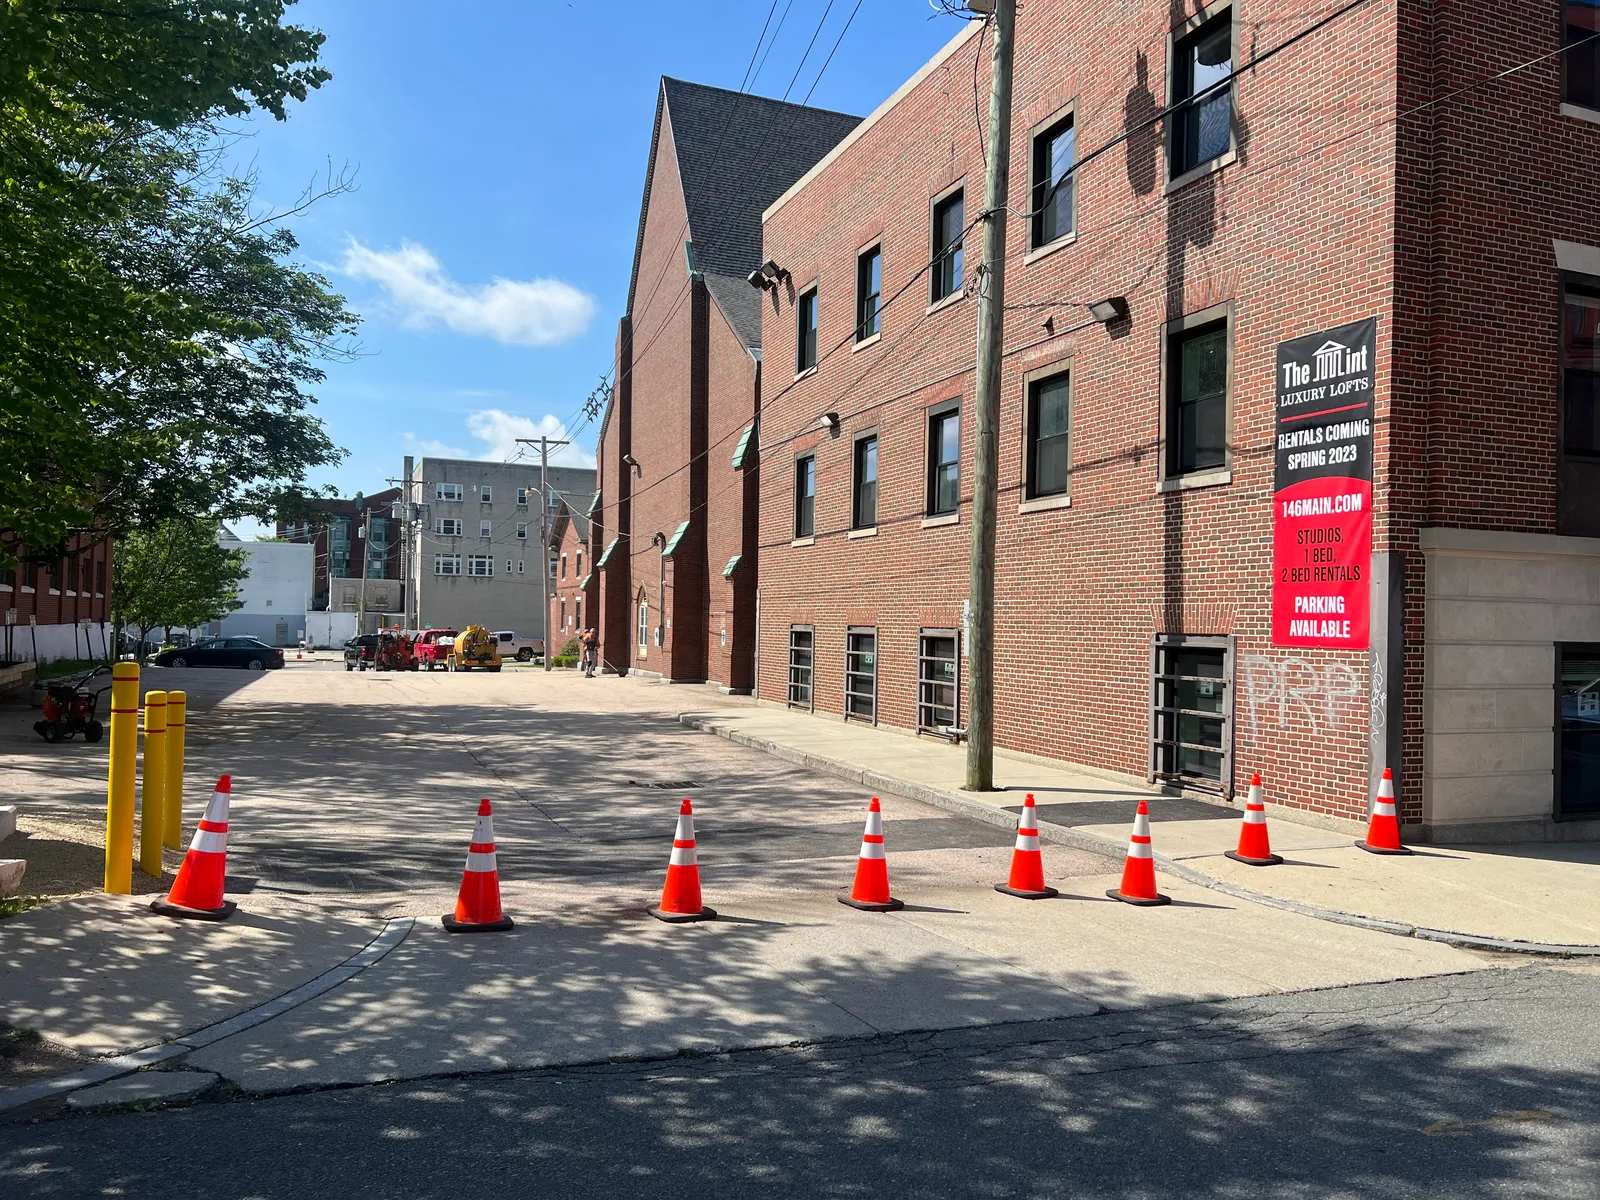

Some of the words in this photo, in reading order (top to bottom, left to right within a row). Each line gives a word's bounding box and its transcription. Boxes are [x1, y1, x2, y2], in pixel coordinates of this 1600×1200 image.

[1282, 361, 1310, 388] The
[1280, 386, 1327, 407] LUXURY
[1329, 377, 1369, 397] LOFTS
[1278, 427, 1323, 450] RENTALS
[1325, 418, 1370, 442] COMING
[1287, 451, 1326, 470] SPRING
[1328, 444, 1357, 464] 2023
[1282, 493, 1362, 518] 146MAIN.COM
[1297, 527, 1344, 545] STUDIOS,
[1304, 548, 1309, 563] 1
[1313, 547, 1336, 563] BED,
[1282, 567, 1288, 583] 2
[1291, 566, 1310, 582] BED
[1314, 565, 1361, 581] RENTALS
[1294, 596, 1345, 614] PARKING
[1289, 619, 1350, 638] AVAILABLE
